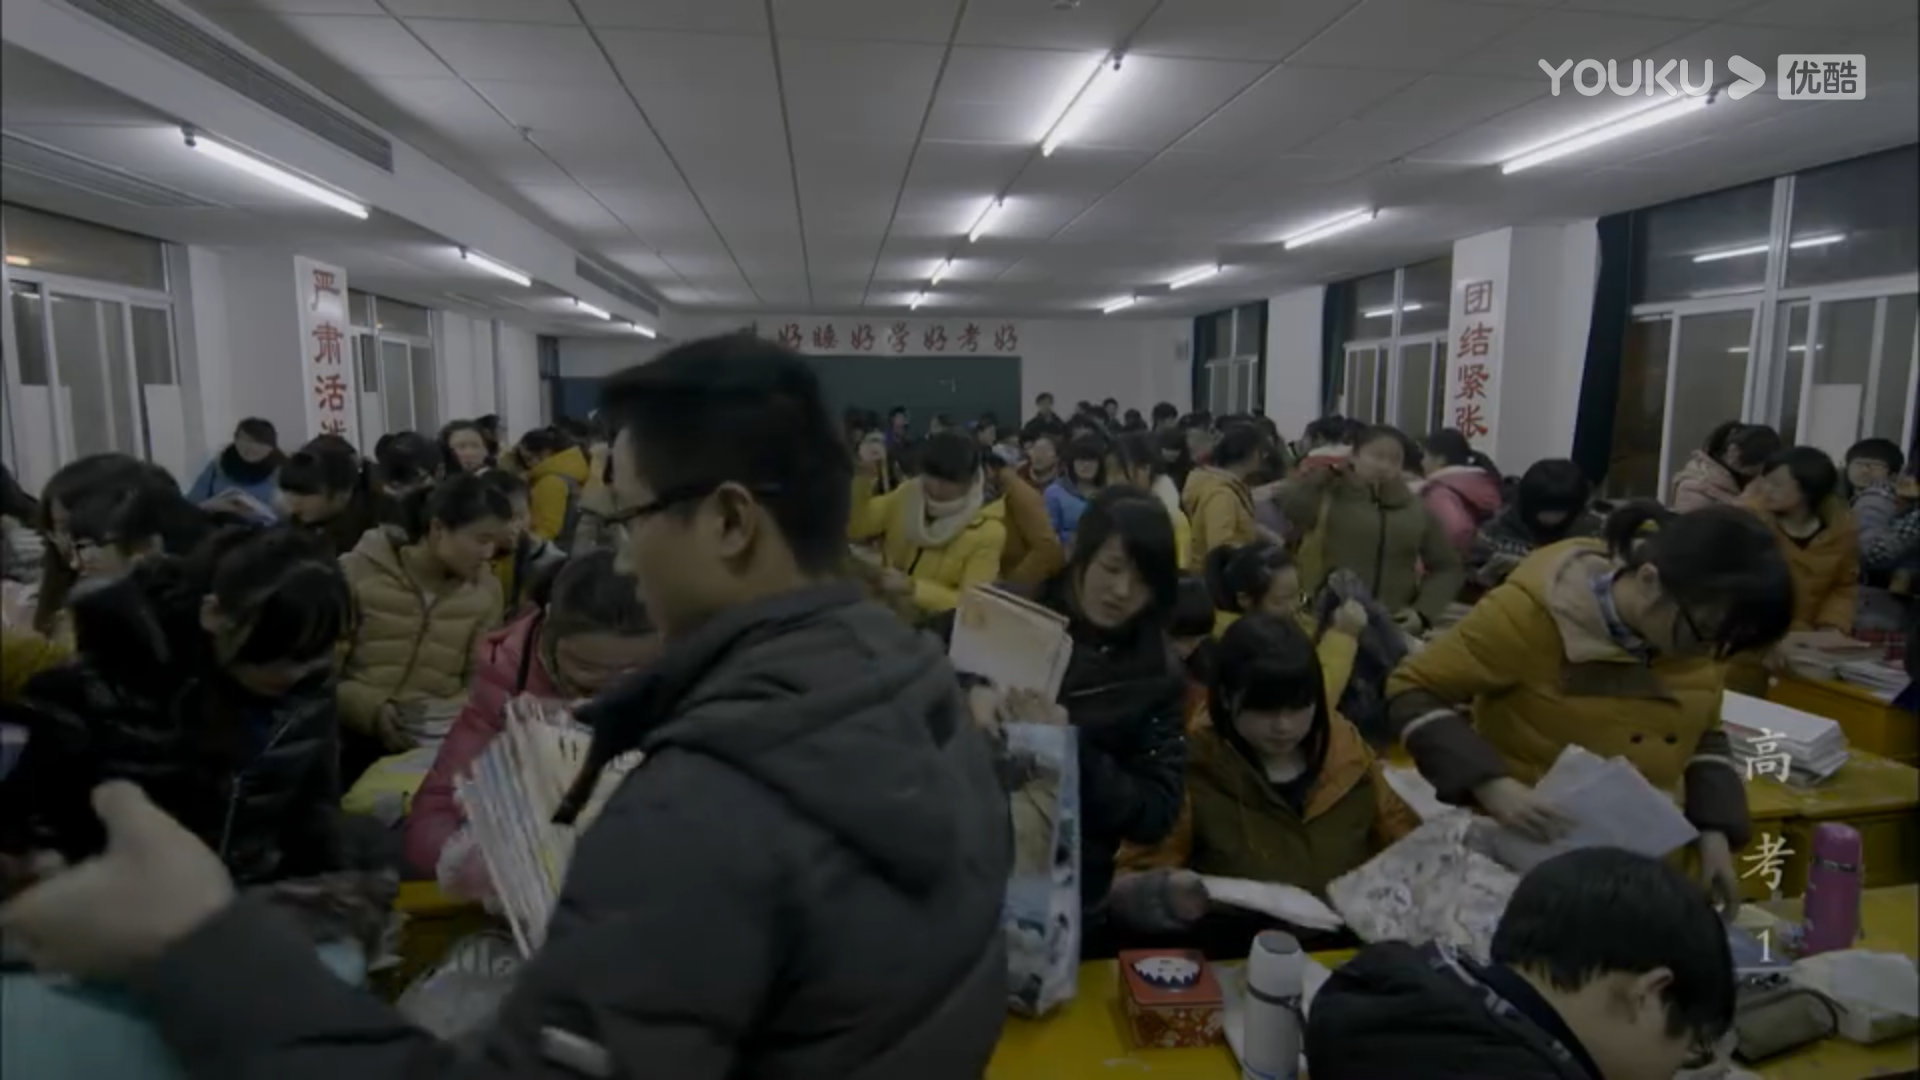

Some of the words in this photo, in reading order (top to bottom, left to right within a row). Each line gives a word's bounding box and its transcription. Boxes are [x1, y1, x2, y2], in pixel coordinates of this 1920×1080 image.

[749, 319, 1018, 352] 好睡好学好考好
[1455, 280, 1493, 438] 团结紧张
